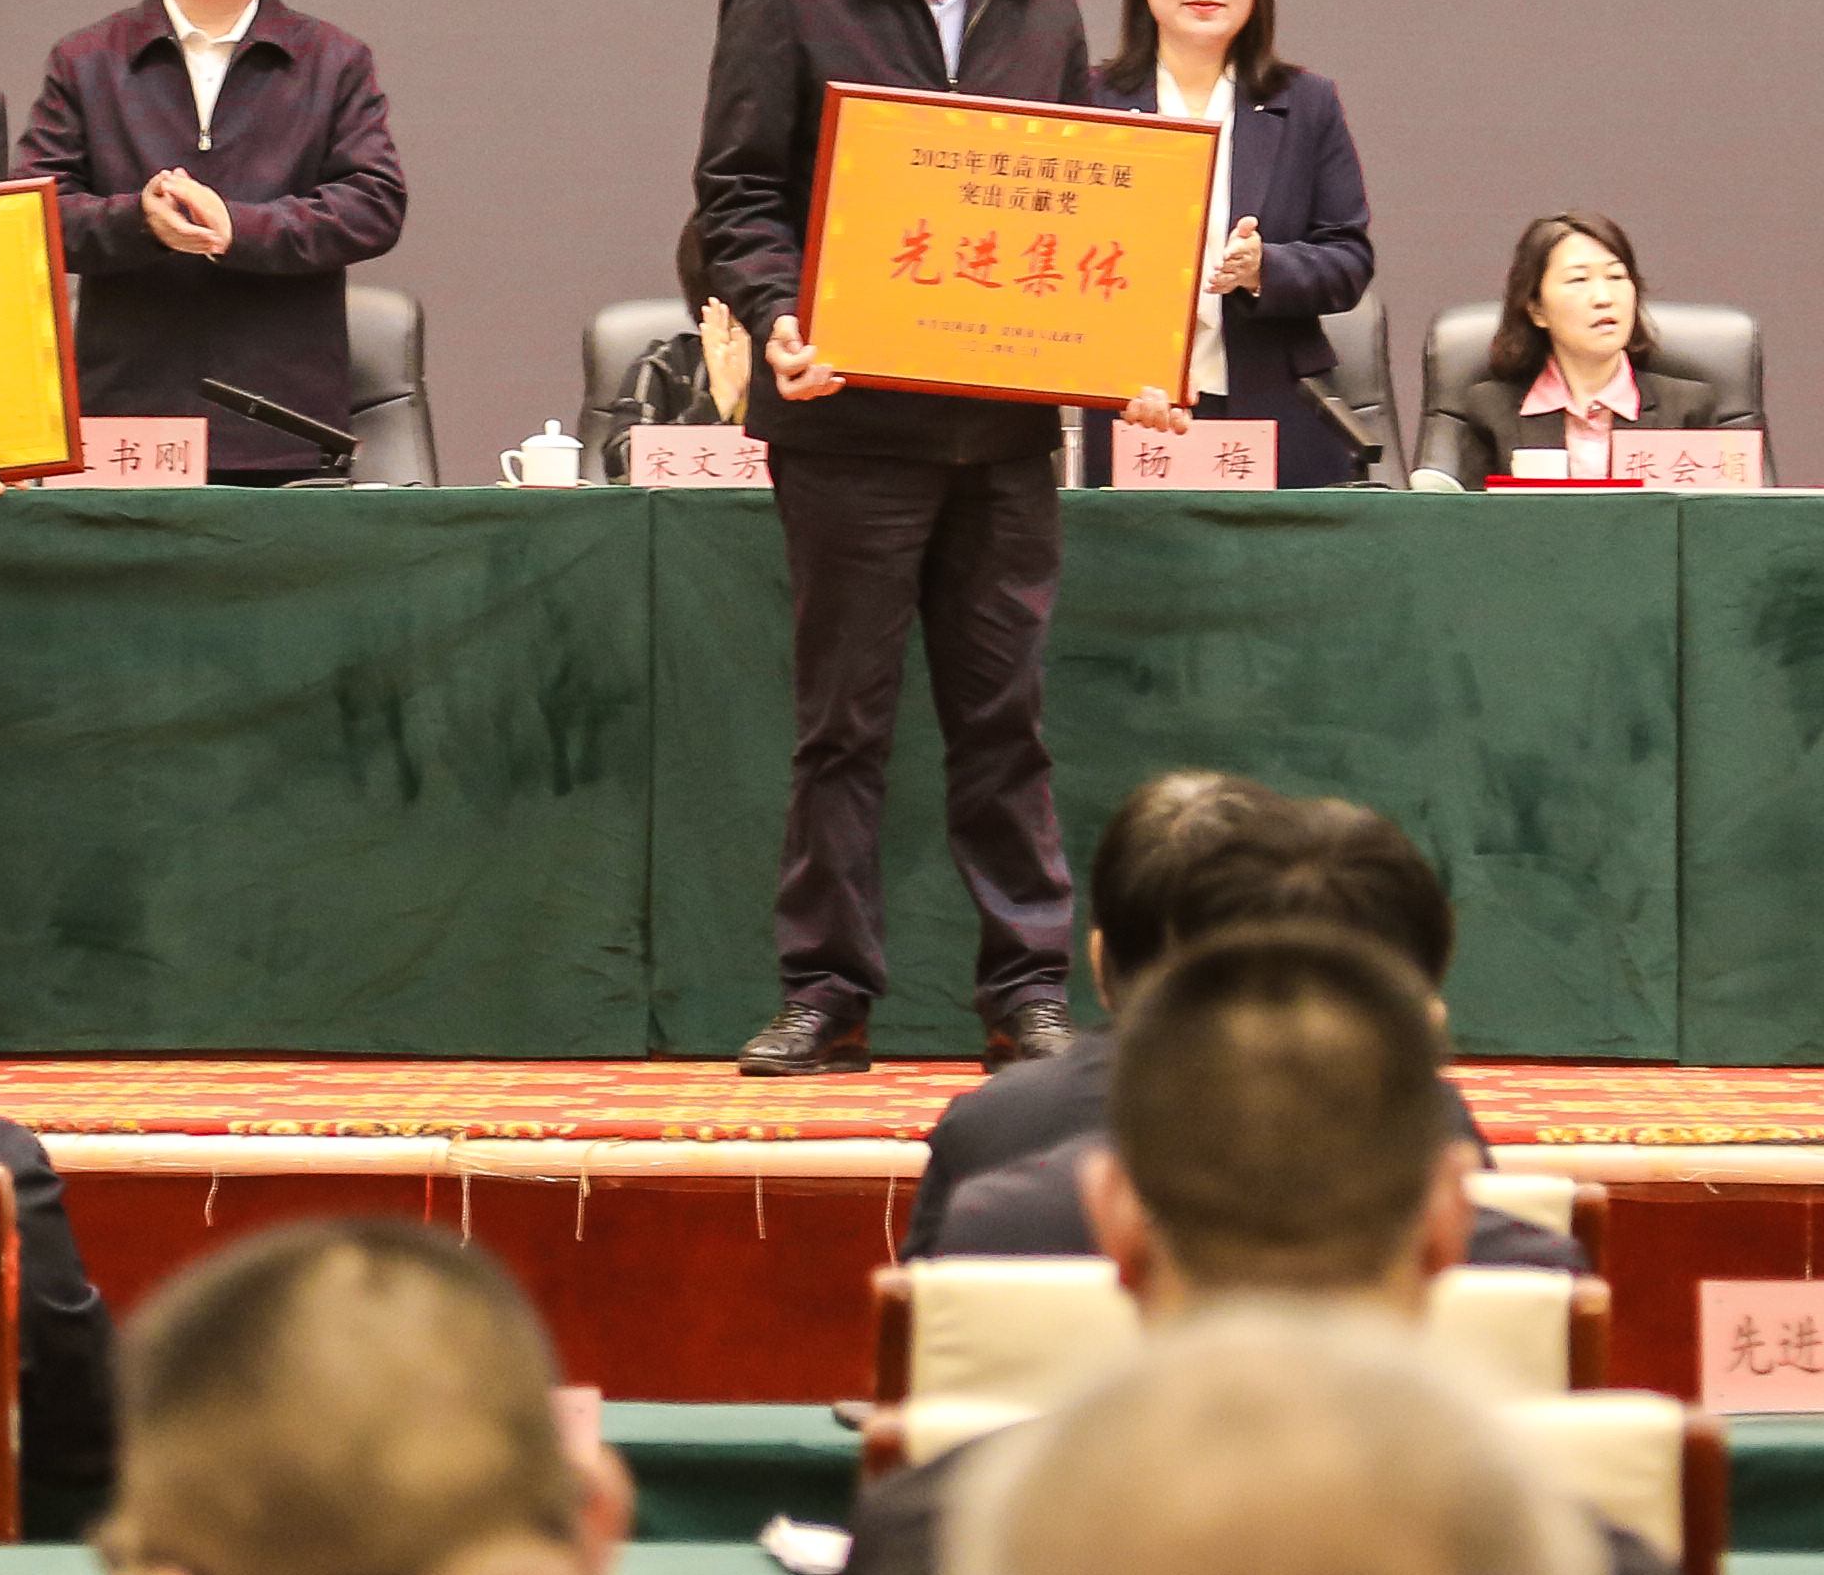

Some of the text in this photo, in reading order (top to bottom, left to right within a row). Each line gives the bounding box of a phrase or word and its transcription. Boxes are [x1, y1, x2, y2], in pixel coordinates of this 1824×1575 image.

[910, 148, 1133, 189] 2023年度高质量发展
[959, 181, 1080, 215] 突出贡献奖
[889, 217, 1128, 302] 先进集体
[81, 438, 190, 476] 书刚
[646, 446, 769, 480] 宋文芳
[1625, 449, 1748, 484] 张会娟
